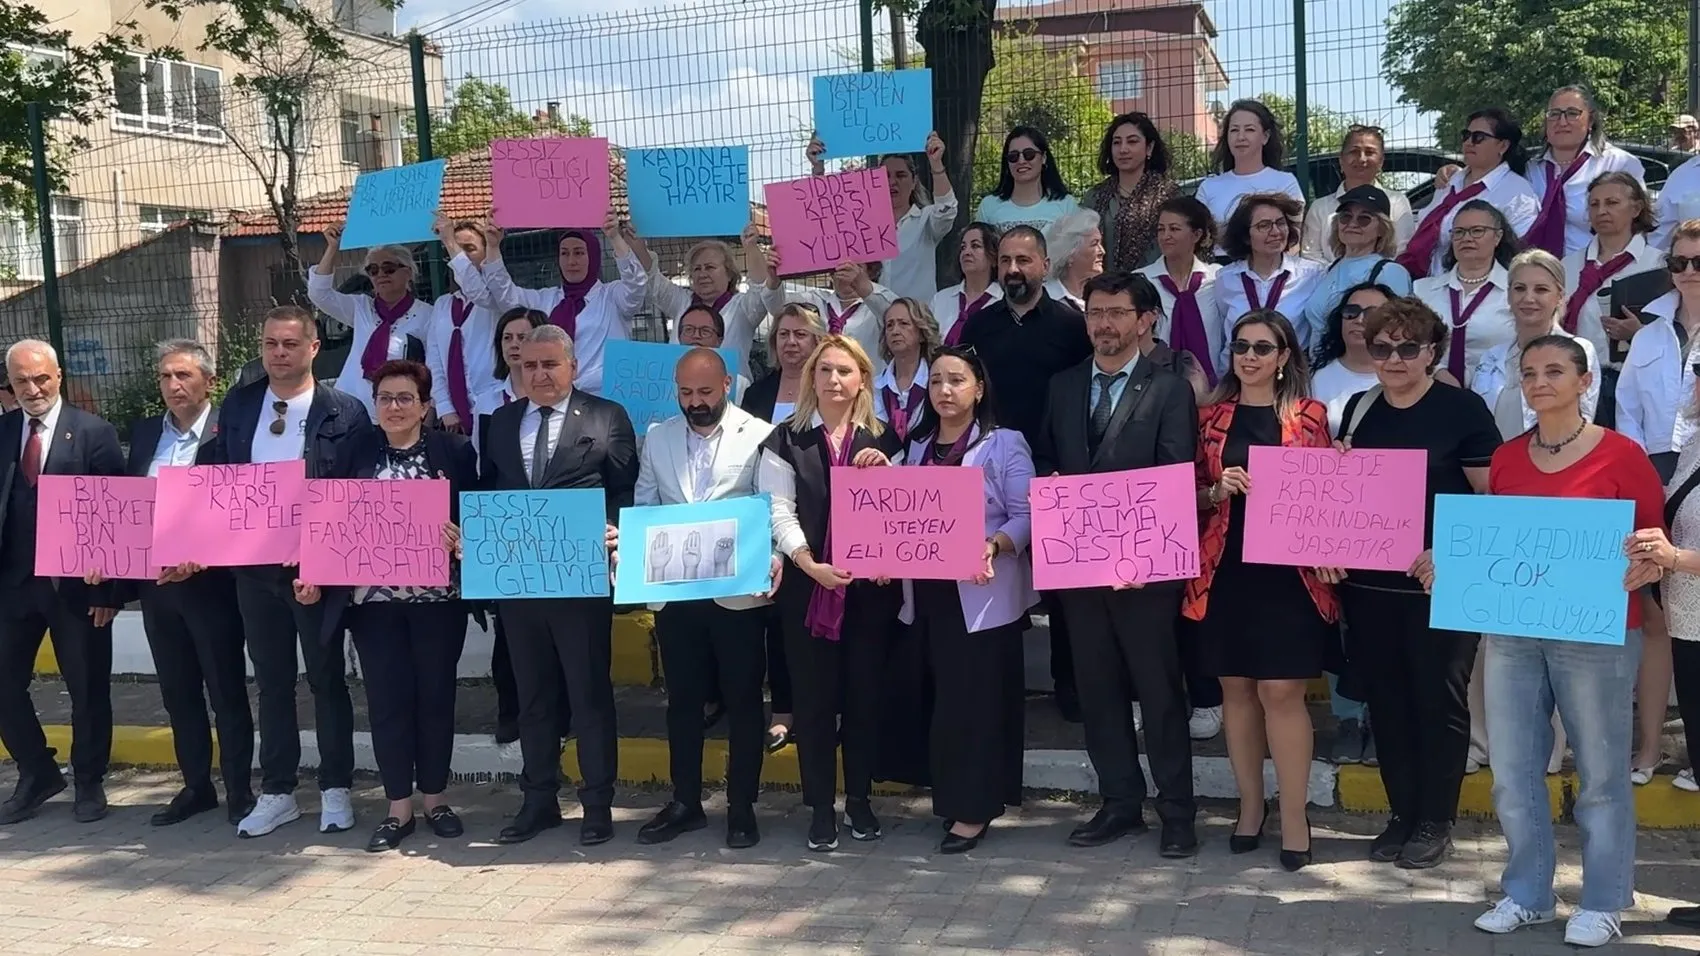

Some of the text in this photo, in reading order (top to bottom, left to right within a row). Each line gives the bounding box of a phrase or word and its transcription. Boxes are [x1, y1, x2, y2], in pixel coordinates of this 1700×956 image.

[825, 70, 896, 92] YARDIM
[641, 146, 733, 168] KADINA
[538, 177, 590, 200] DUY
[666, 183, 736, 206] HAYIR
[810, 208, 871, 236] TEK
[799, 224, 896, 264] YÜREK
[74, 476, 118, 501] BIR
[848, 487, 944, 513] YARDIM
[58, 499, 155, 526] HAREKET
[229, 503, 302, 531] EL ELE
[1061, 505, 1158, 538] KALMA
[1269, 502, 1412, 531] FARKINDALIK
[76, 522, 115, 546] BIN
[1041, 522, 1189, 565] DESTEK
[1288, 531, 1396, 565] YAŞATIR
[1512, 526, 1624, 561] KADINLA
[59, 545, 152, 579] UMUT
[329, 545, 447, 583] YAŞATIR
[895, 539, 945, 562] GÖR
[494, 562, 608, 597] GELME
[1487, 557, 1554, 588] ÇOK
